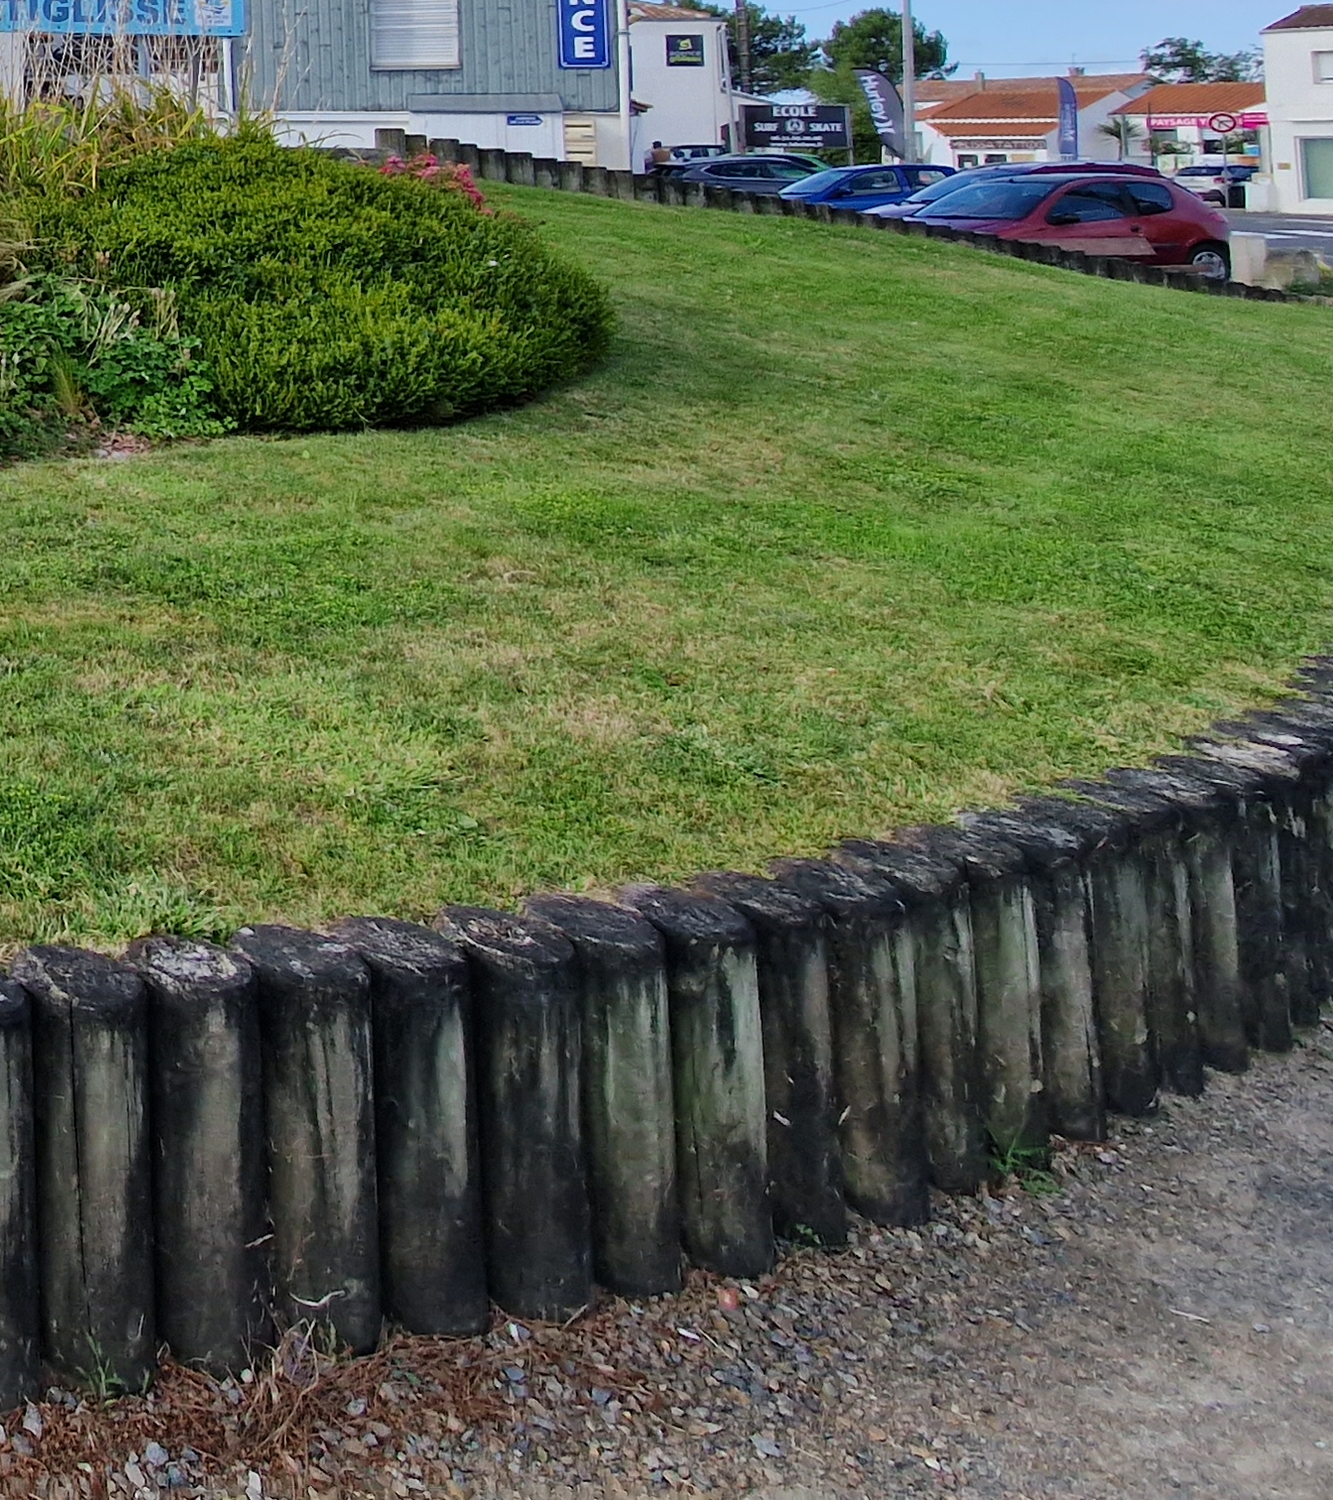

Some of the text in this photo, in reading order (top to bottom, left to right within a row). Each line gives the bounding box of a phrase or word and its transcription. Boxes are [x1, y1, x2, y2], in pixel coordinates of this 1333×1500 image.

[859, 74, 889, 121] Hurley
[773, 106, 819, 117] ECOLE
[753, 122, 844, 132] SURF SKATE
[1150, 118, 1198, 127] PAYSAGE
